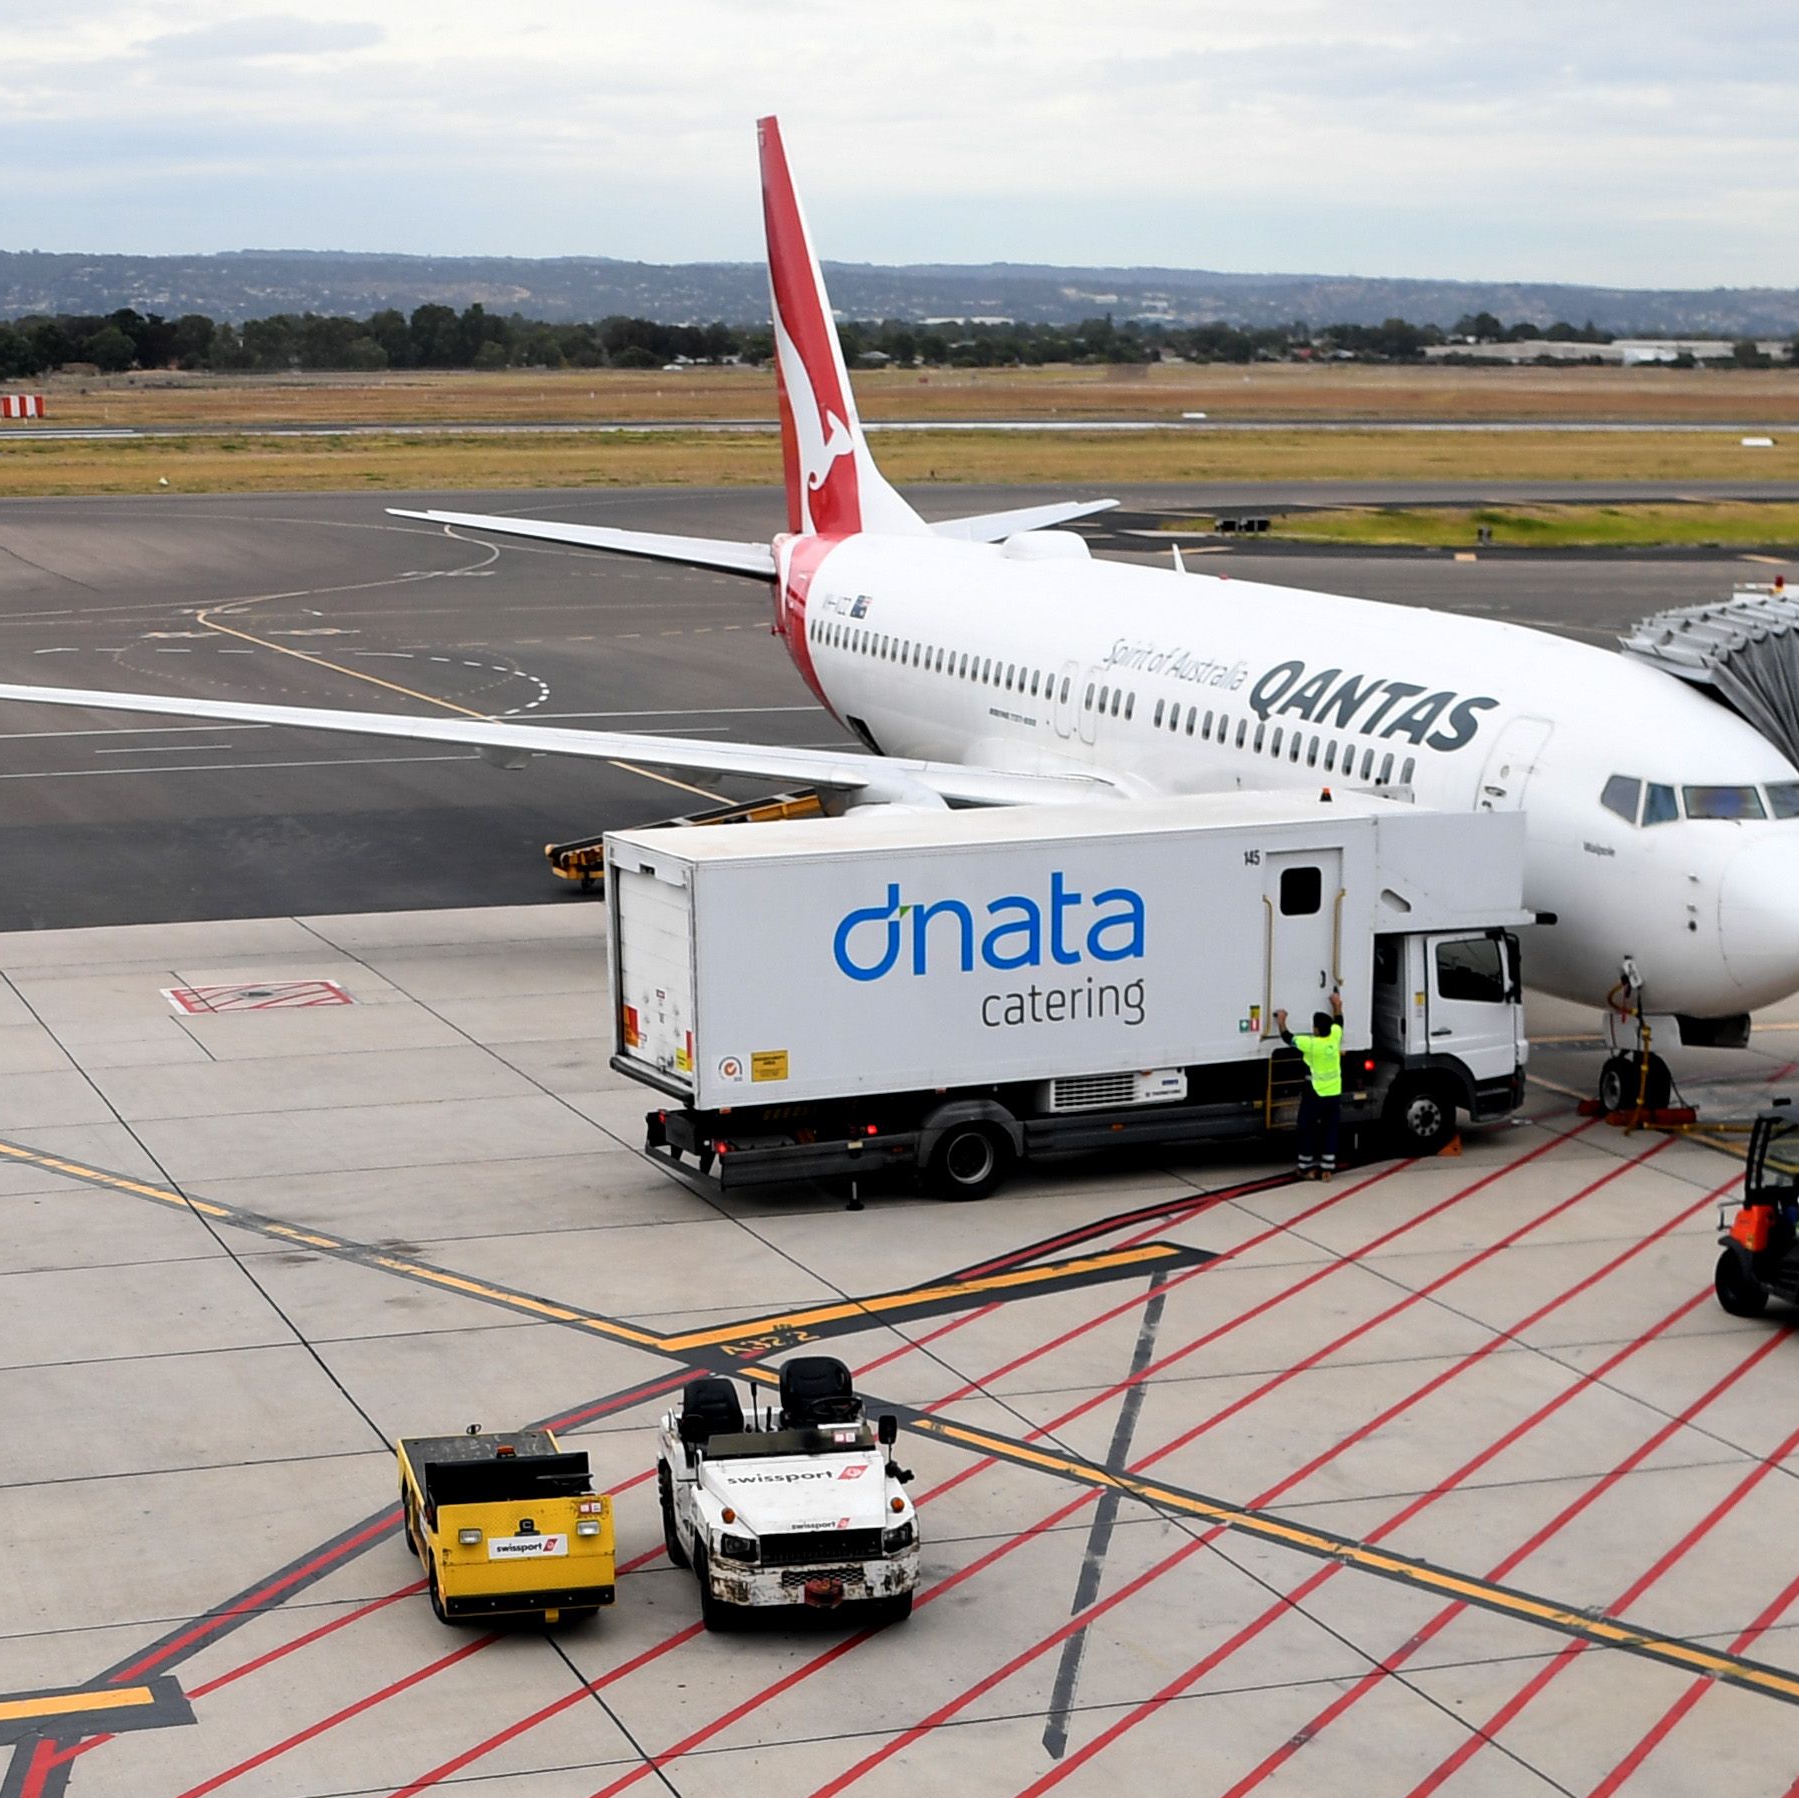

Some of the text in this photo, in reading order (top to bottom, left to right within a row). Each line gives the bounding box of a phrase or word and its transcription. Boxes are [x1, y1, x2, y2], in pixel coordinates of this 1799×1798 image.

[1103, 638, 1248, 690] Spirit of Australia
[1249, 660, 1501, 752] QANTAS
[1244, 850, 1260, 865] 145
[833, 872, 1145, 982] dnata
[982, 976, 1145, 1028] catering
[727, 1470, 833, 1484] swissport
[791, 1520, 836, 1530] swissport
[496, 1541, 543, 1553] swissport
